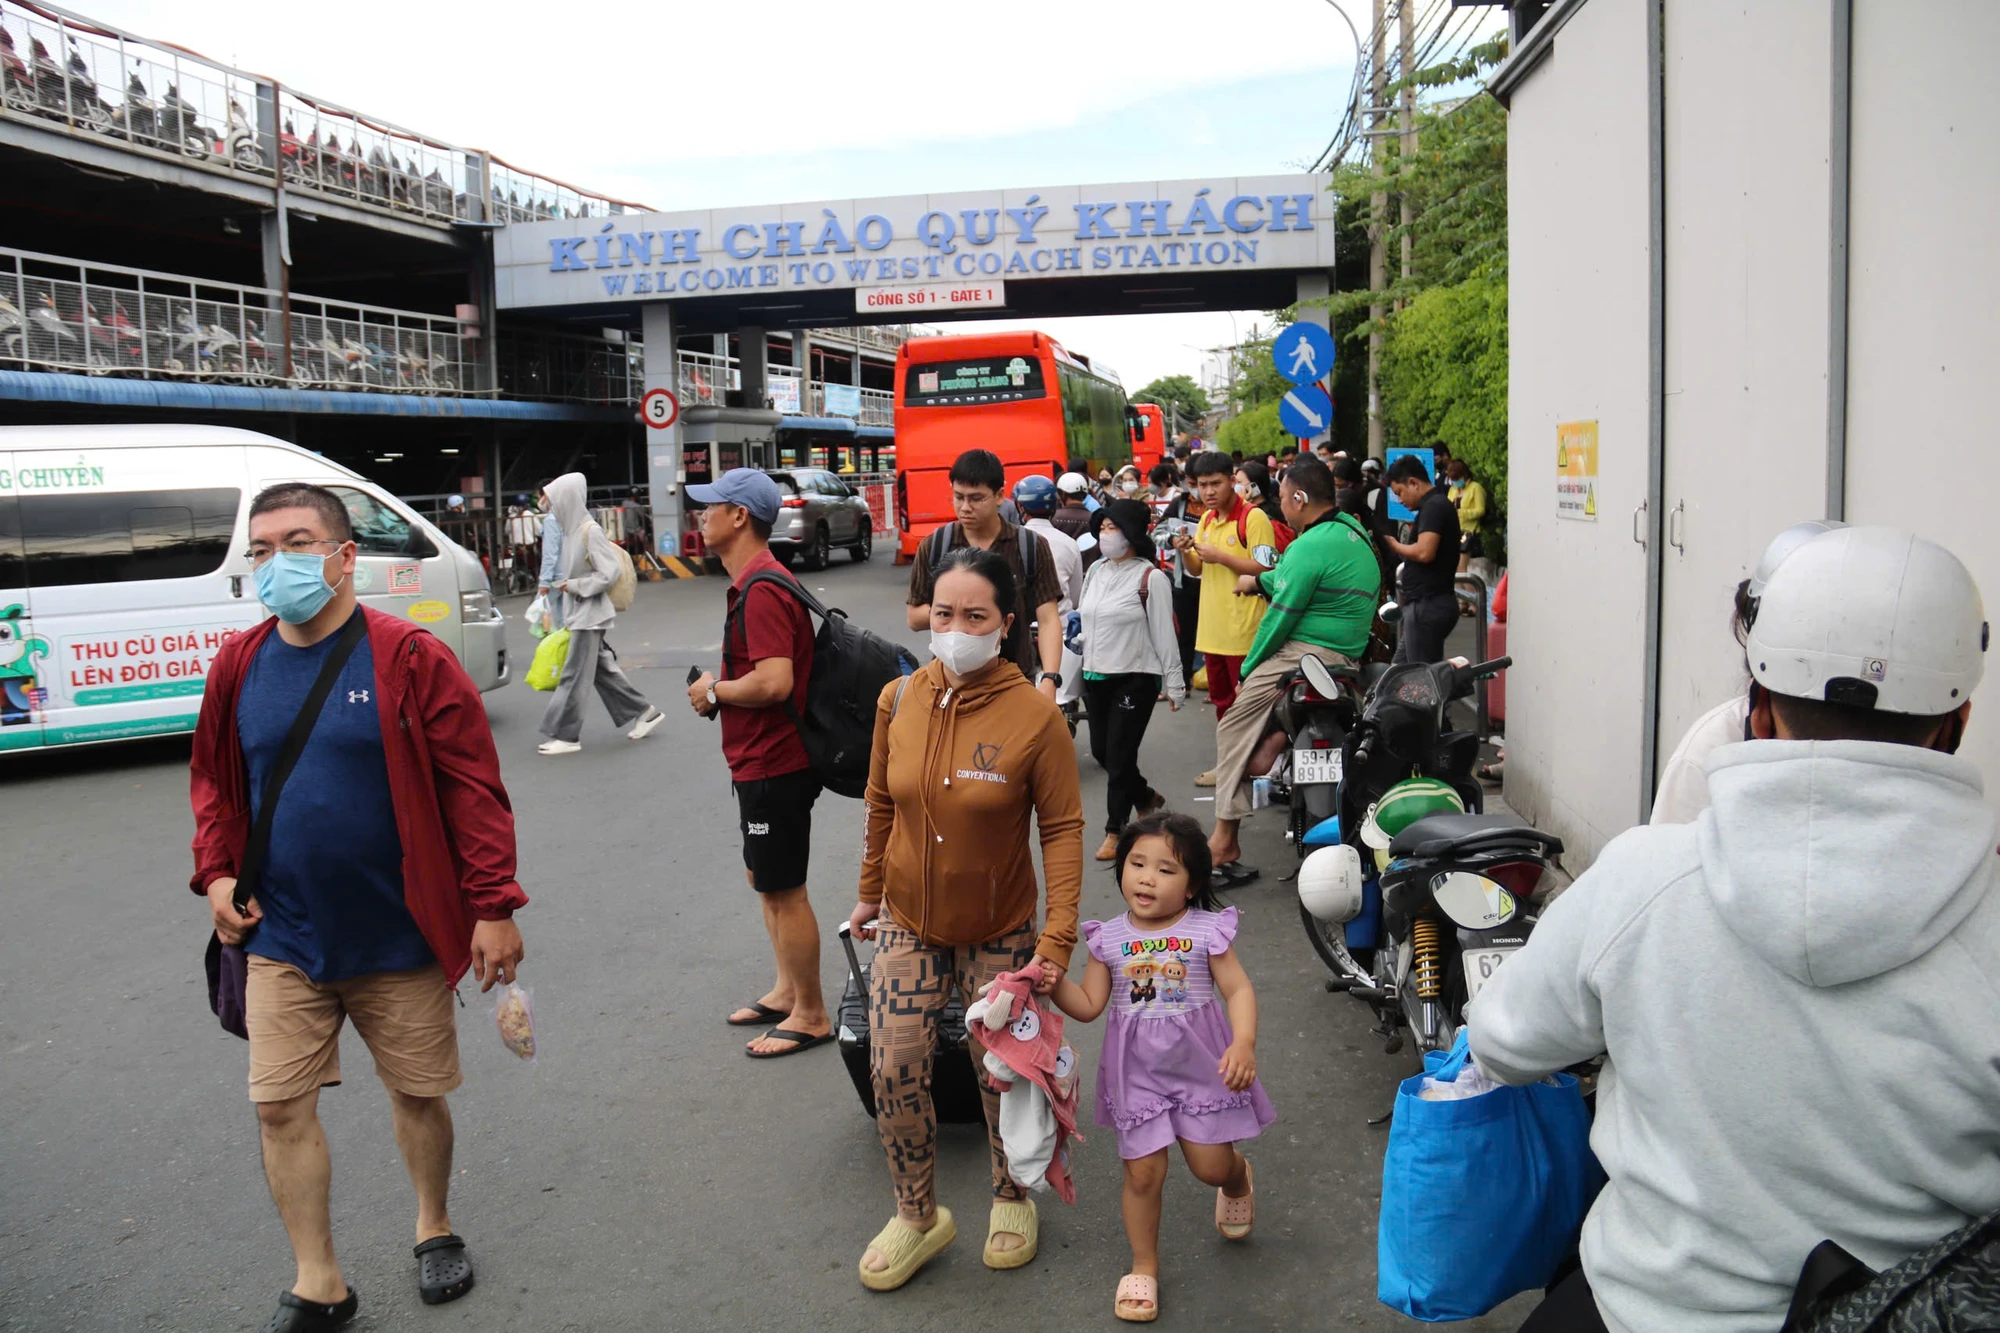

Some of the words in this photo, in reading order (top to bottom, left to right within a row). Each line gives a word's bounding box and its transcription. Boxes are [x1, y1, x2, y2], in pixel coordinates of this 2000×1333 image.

[549, 222, 701, 272] KÍNH
[723, 208, 893, 259] CHÀO
[917, 194, 1049, 254] QUÝ
[1073, 188, 1315, 239] KHÁCH
[603, 263, 779, 295] WELCOME
[788, 262, 836, 284] TO
[843, 254, 945, 282] WEST
[954, 247, 1082, 275] COACH
[1093, 240, 1259, 269] STATION
[908, 288, 925, 304] SỐ
[930, 292, 936, 303] 1
[951, 289, 982, 302] GATE
[987, 289, 993, 301] 1
[654, 400, 665, 417] 5
[70, 641, 118, 661] THU
[125, 635, 155, 656] CŨ
[162, 630, 199, 652] GIÁ
[71, 665, 113, 687] LÊN
[120, 660, 160, 682] ĐỜI
[166, 656, 203, 678] GIÁ
[956, 769, 1008, 783] CONVENTIONAL
[1297, 766, 1343, 781] 891.6
[1121, 937, 1192, 957] LABUBU
